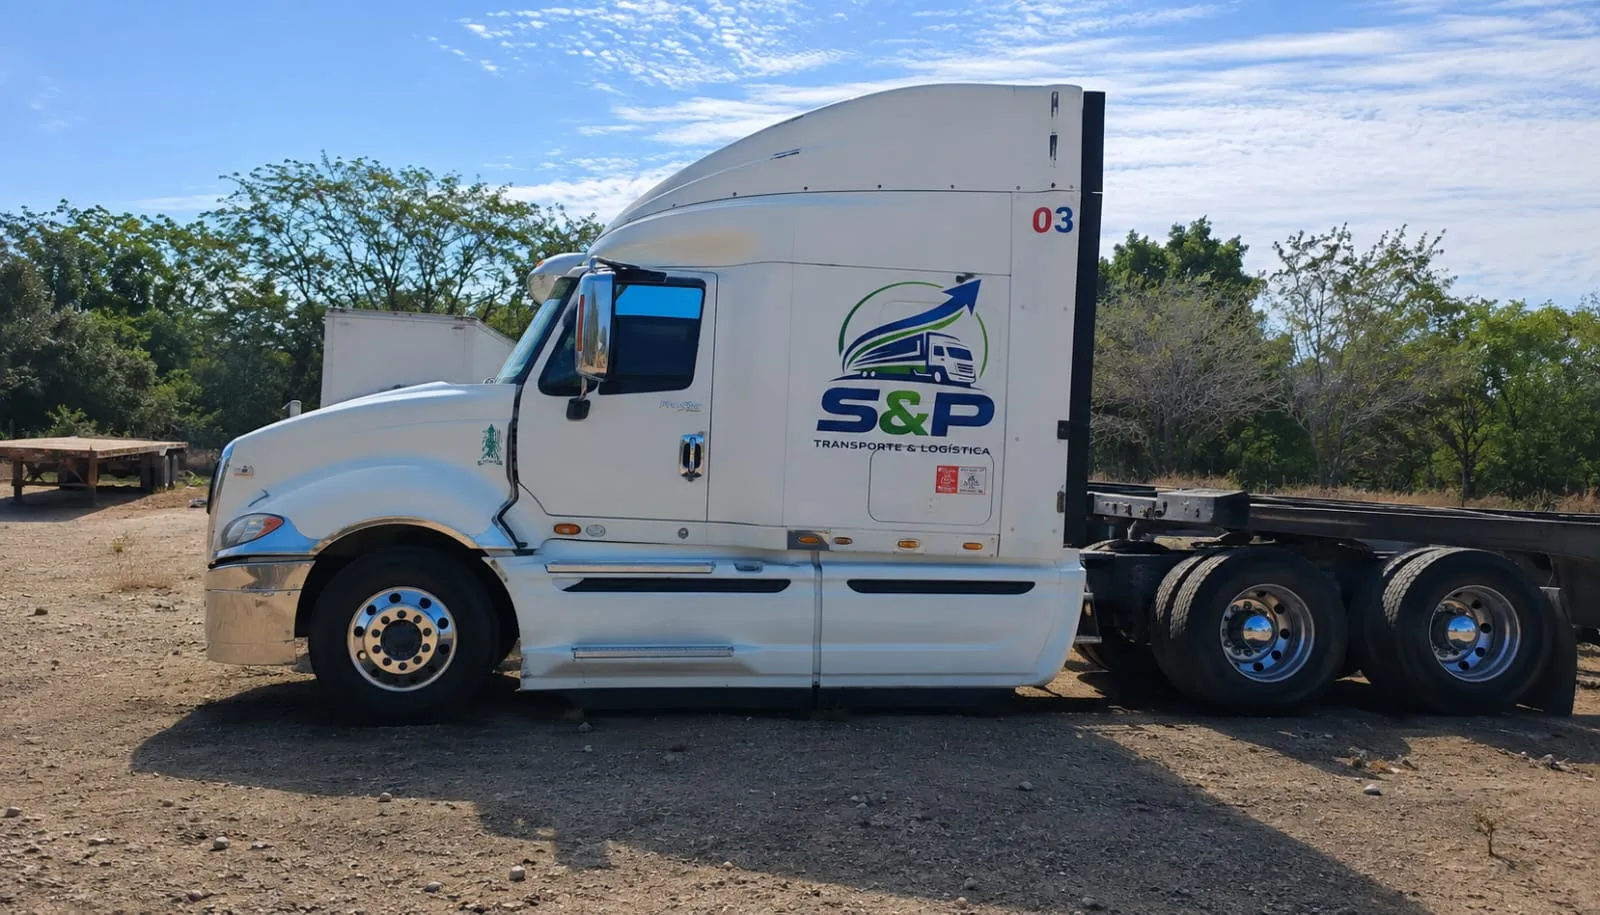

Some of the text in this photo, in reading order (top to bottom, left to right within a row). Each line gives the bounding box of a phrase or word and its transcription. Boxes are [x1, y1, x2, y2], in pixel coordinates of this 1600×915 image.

[1033, 206, 1073, 233] 03
[816, 387, 995, 437] S&P
[814, 439, 991, 456] TRANSPORTE & LOGÍSTICA
